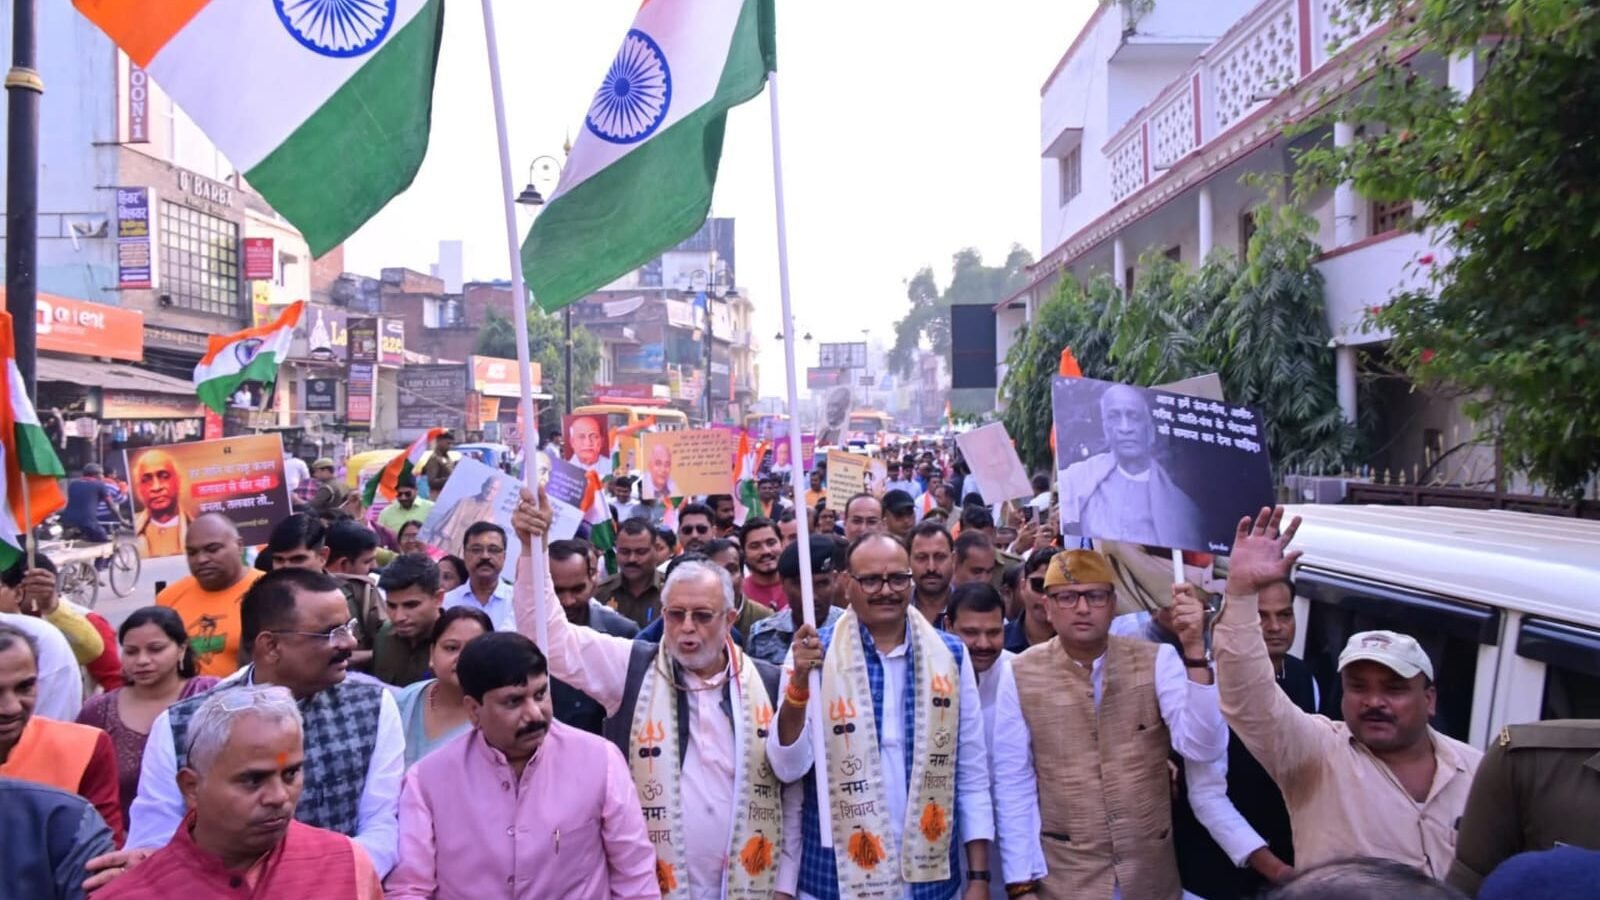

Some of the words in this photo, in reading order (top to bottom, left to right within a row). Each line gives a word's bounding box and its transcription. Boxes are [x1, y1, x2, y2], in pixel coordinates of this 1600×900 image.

[1156, 395, 1175, 406] आज
[1201, 432, 1215, 444] कर
[930, 753, 949, 767] नमः
[754, 784, 772, 798] नमः
[840, 780, 870, 794] नमः
